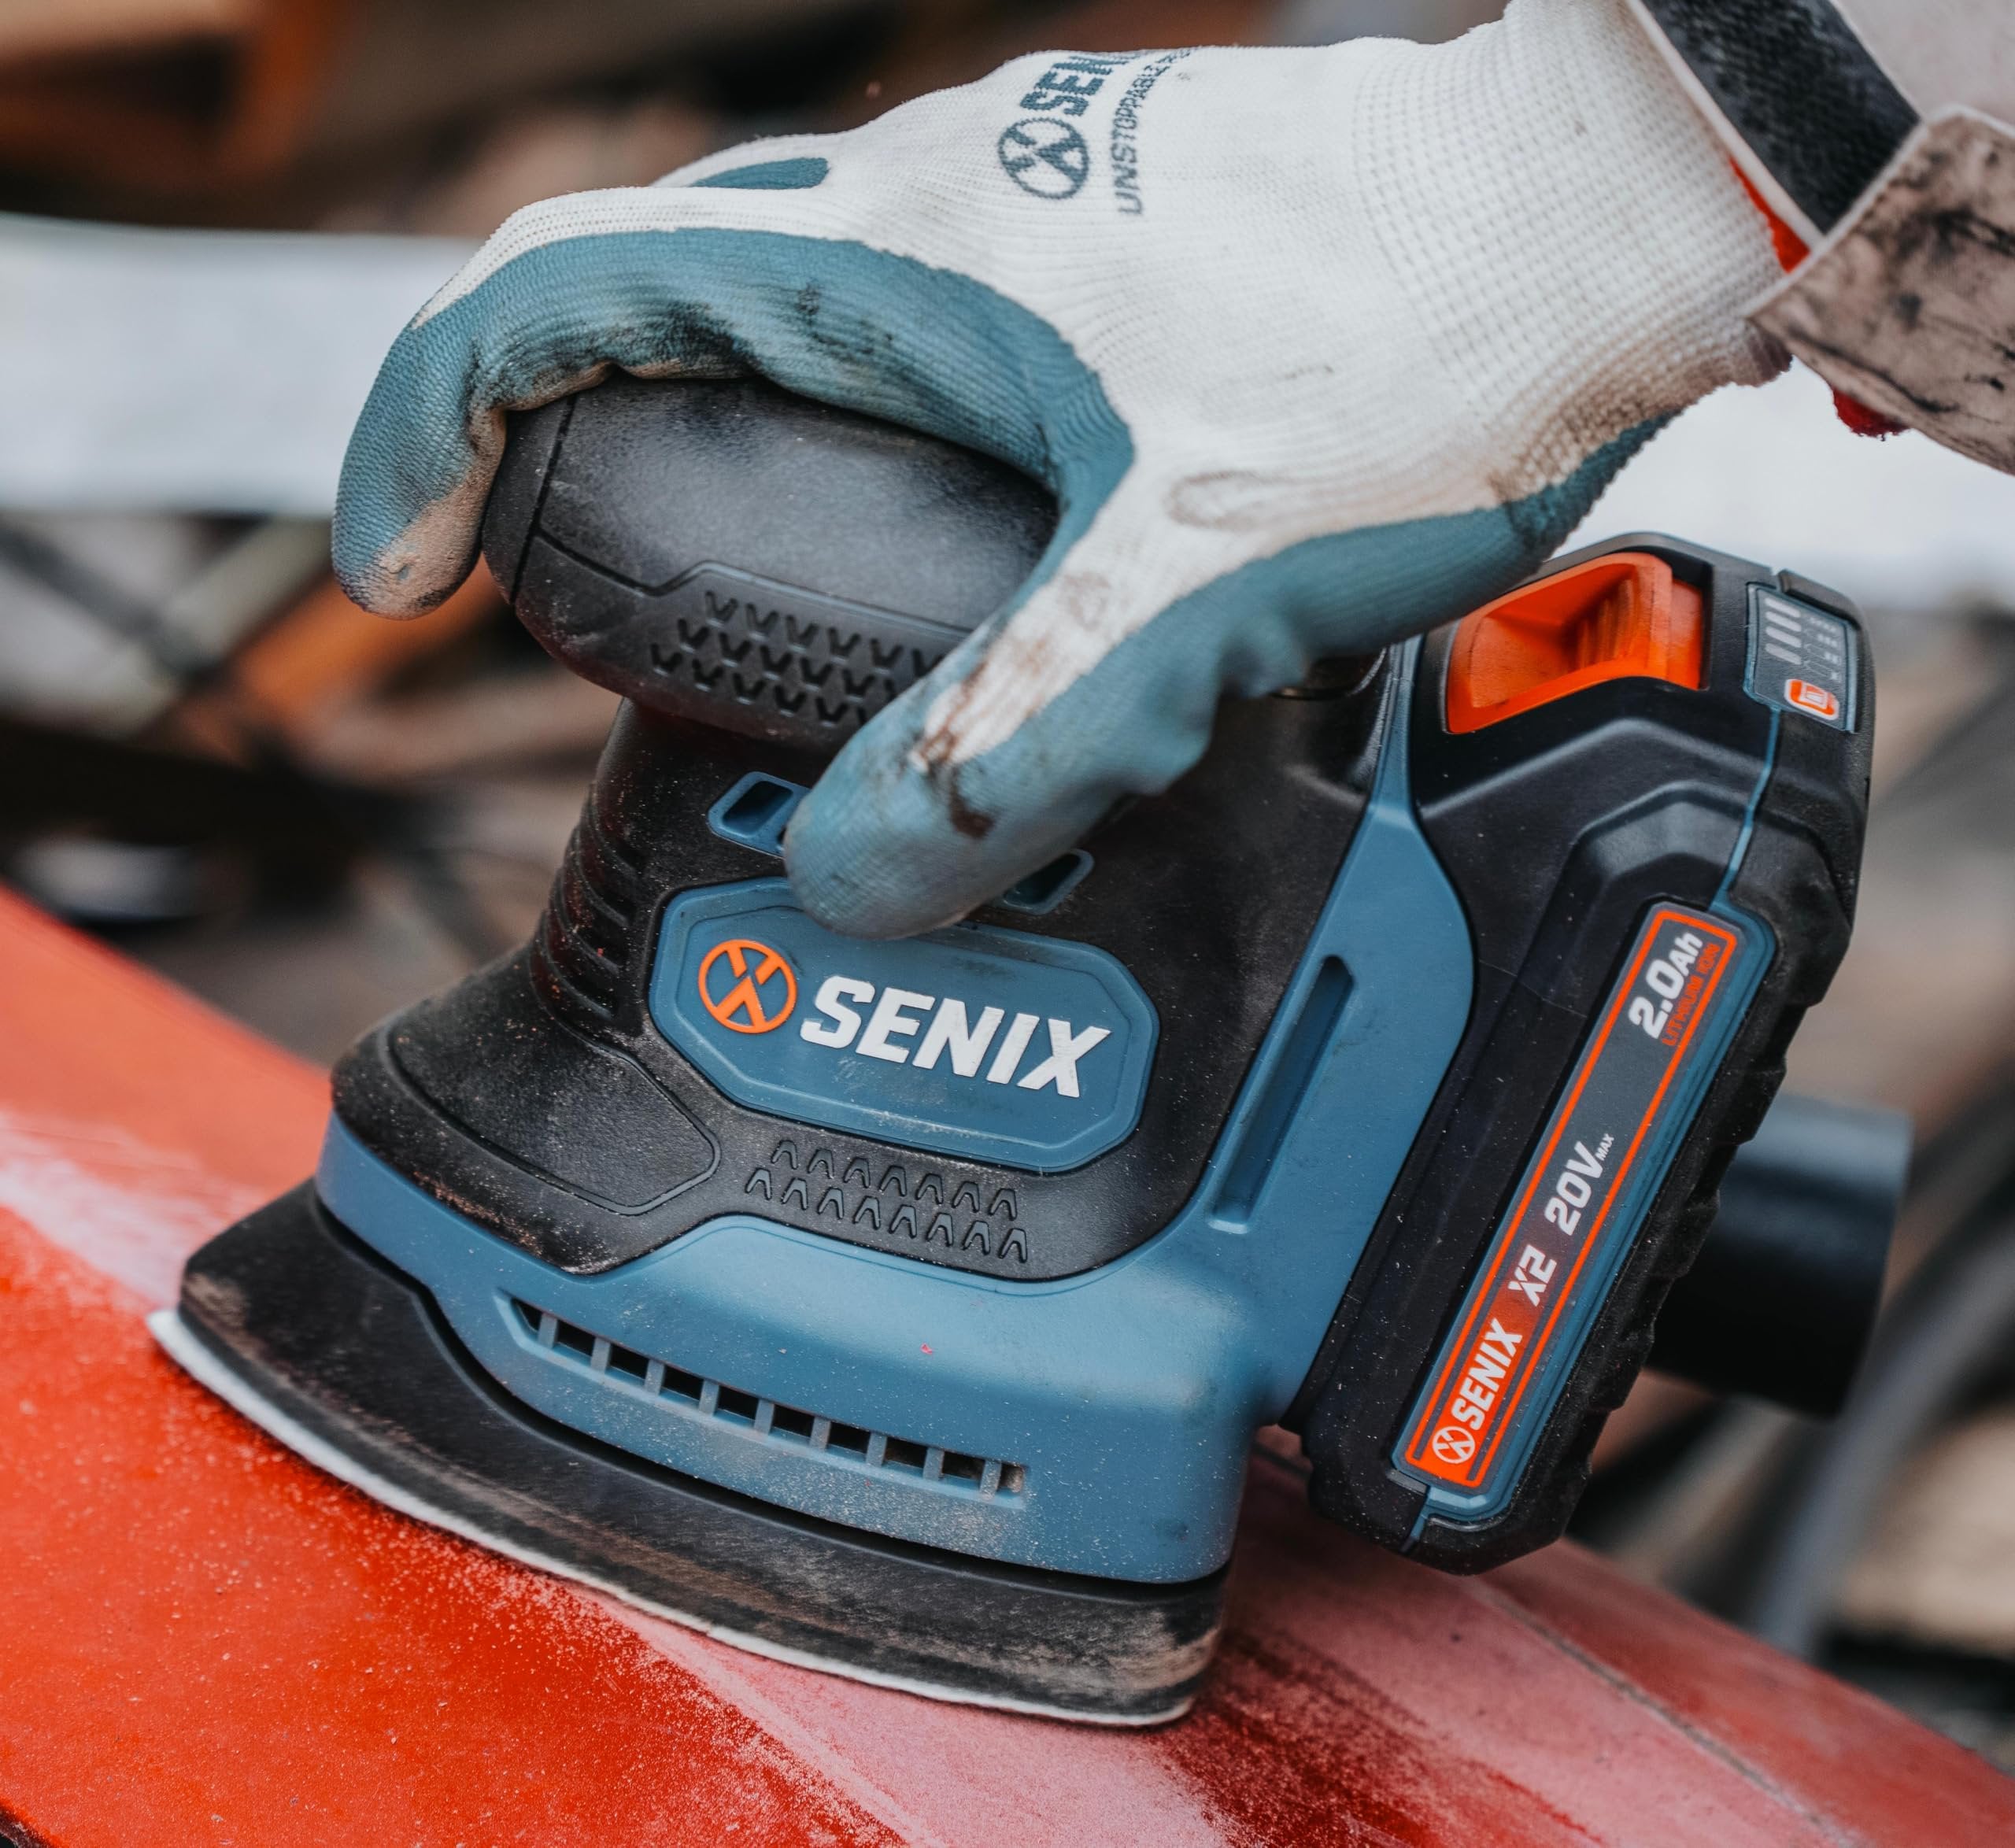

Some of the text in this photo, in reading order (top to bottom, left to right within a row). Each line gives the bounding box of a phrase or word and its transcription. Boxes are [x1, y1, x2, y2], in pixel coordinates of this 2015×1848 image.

[800, 975, 1111, 1098] SENIX
[1629, 932, 1703, 1039] 2.0Ah
[1662, 942, 1721, 1047] LITHIUM ION
[1451, 1318, 1523, 1431] SENIX
[1507, 1244, 1558, 1307] X2
[1544, 1141, 1603, 1236] 20V
